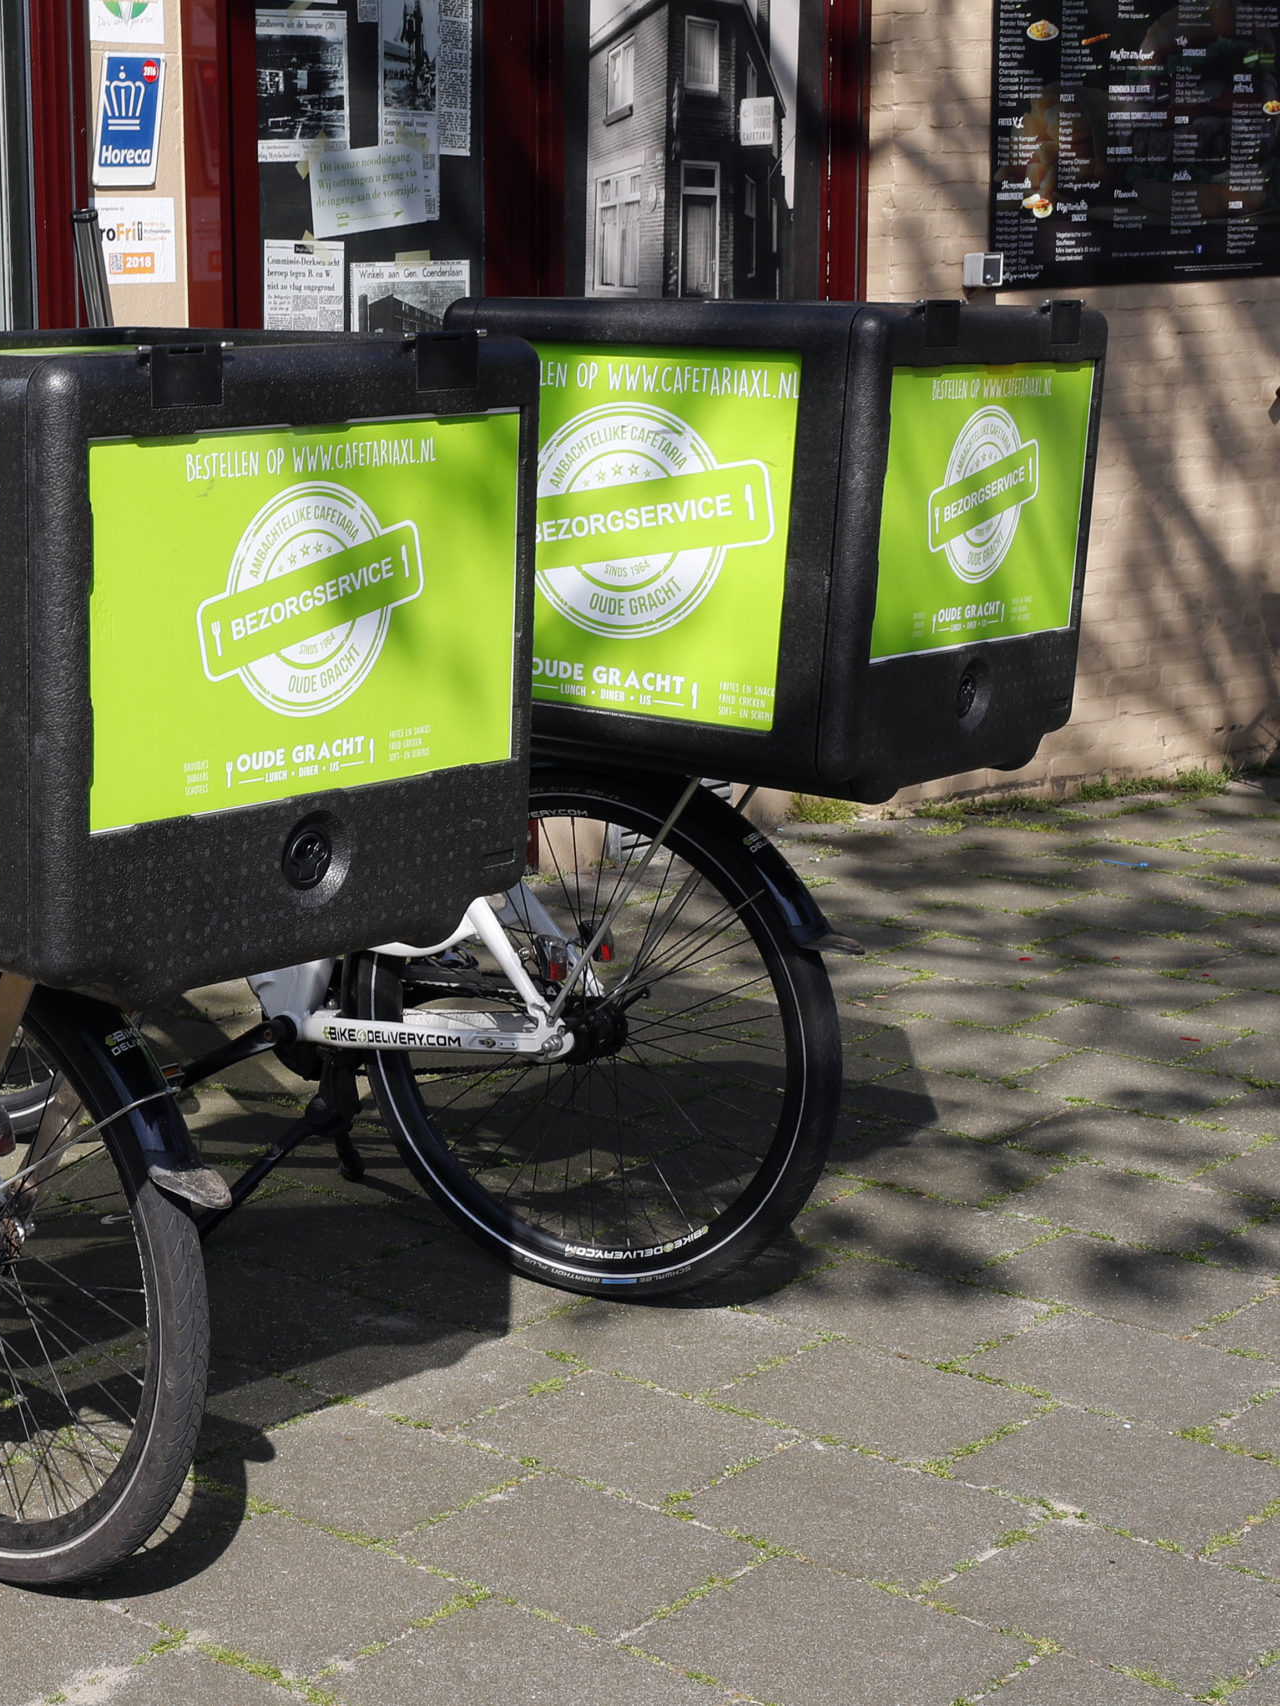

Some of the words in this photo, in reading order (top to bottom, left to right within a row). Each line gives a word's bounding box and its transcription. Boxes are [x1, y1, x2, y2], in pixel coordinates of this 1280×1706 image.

[101, 145, 151, 165] Horeca
[341, 161, 360, 170] onze
[317, 178, 332, 193] Wij
[333, 176, 374, 189] ontvangen
[382, 172, 405, 183] graag
[405, 169, 417, 177] via
[316, 196, 327, 207] de
[327, 195, 355, 208] ingang
[372, 189, 382, 199] de
[125, 255, 152, 269] 2018
[358, 269, 385, 280] Winkels
[388, 271, 400, 279] aan
[422, 266, 463, 278] Coenderslaan
[576, 362, 599, 390] OP
[608, 363, 799, 399] WWW.CAFETARIAXL.NL
[185, 451, 260, 482] BESTELLEN
[266, 447, 285, 475] OP
[292, 436, 437, 474] WWW.CAFETARIAXL.NL
[549, 425, 628, 489] AMBACHTELIJKE
[630, 425, 688, 471] CAFETARIA
[943, 466, 1025, 523] BEZORGSERVICE
[535, 494, 733, 543] BEZORGSERVICE
[249, 505, 312, 580] AMBACHTELIJKE
[313, 504, 359, 542] CAFETARIA
[603, 564, 628, 578] SINDS
[630, 561, 651, 577] 1964
[230, 557, 394, 641] BEZORGSERVICE
[589, 592, 625, 616] OUDE
[629, 576, 682, 616] GRACHT
[937, 606, 962, 623] OUDE
[964, 600, 1001, 619] GRACHT
[288, 674, 317, 694] OUDE
[320, 642, 361, 690] GRACHT
[532, 657, 584, 681] OUDE
[592, 665, 686, 695] GRACHT
[560, 683, 586, 696] LUNCH
[600, 688, 625, 702] DINER
[639, 694, 652, 706] IJS
[236, 748, 286, 773] OUDE
[291, 736, 365, 764] GRACHT
[265, 769, 288, 783] LUNCH
[298, 764, 319, 778] DINER
[329, 761, 341, 774] IJS
[551, 1267, 601, 1284] MARATHON
